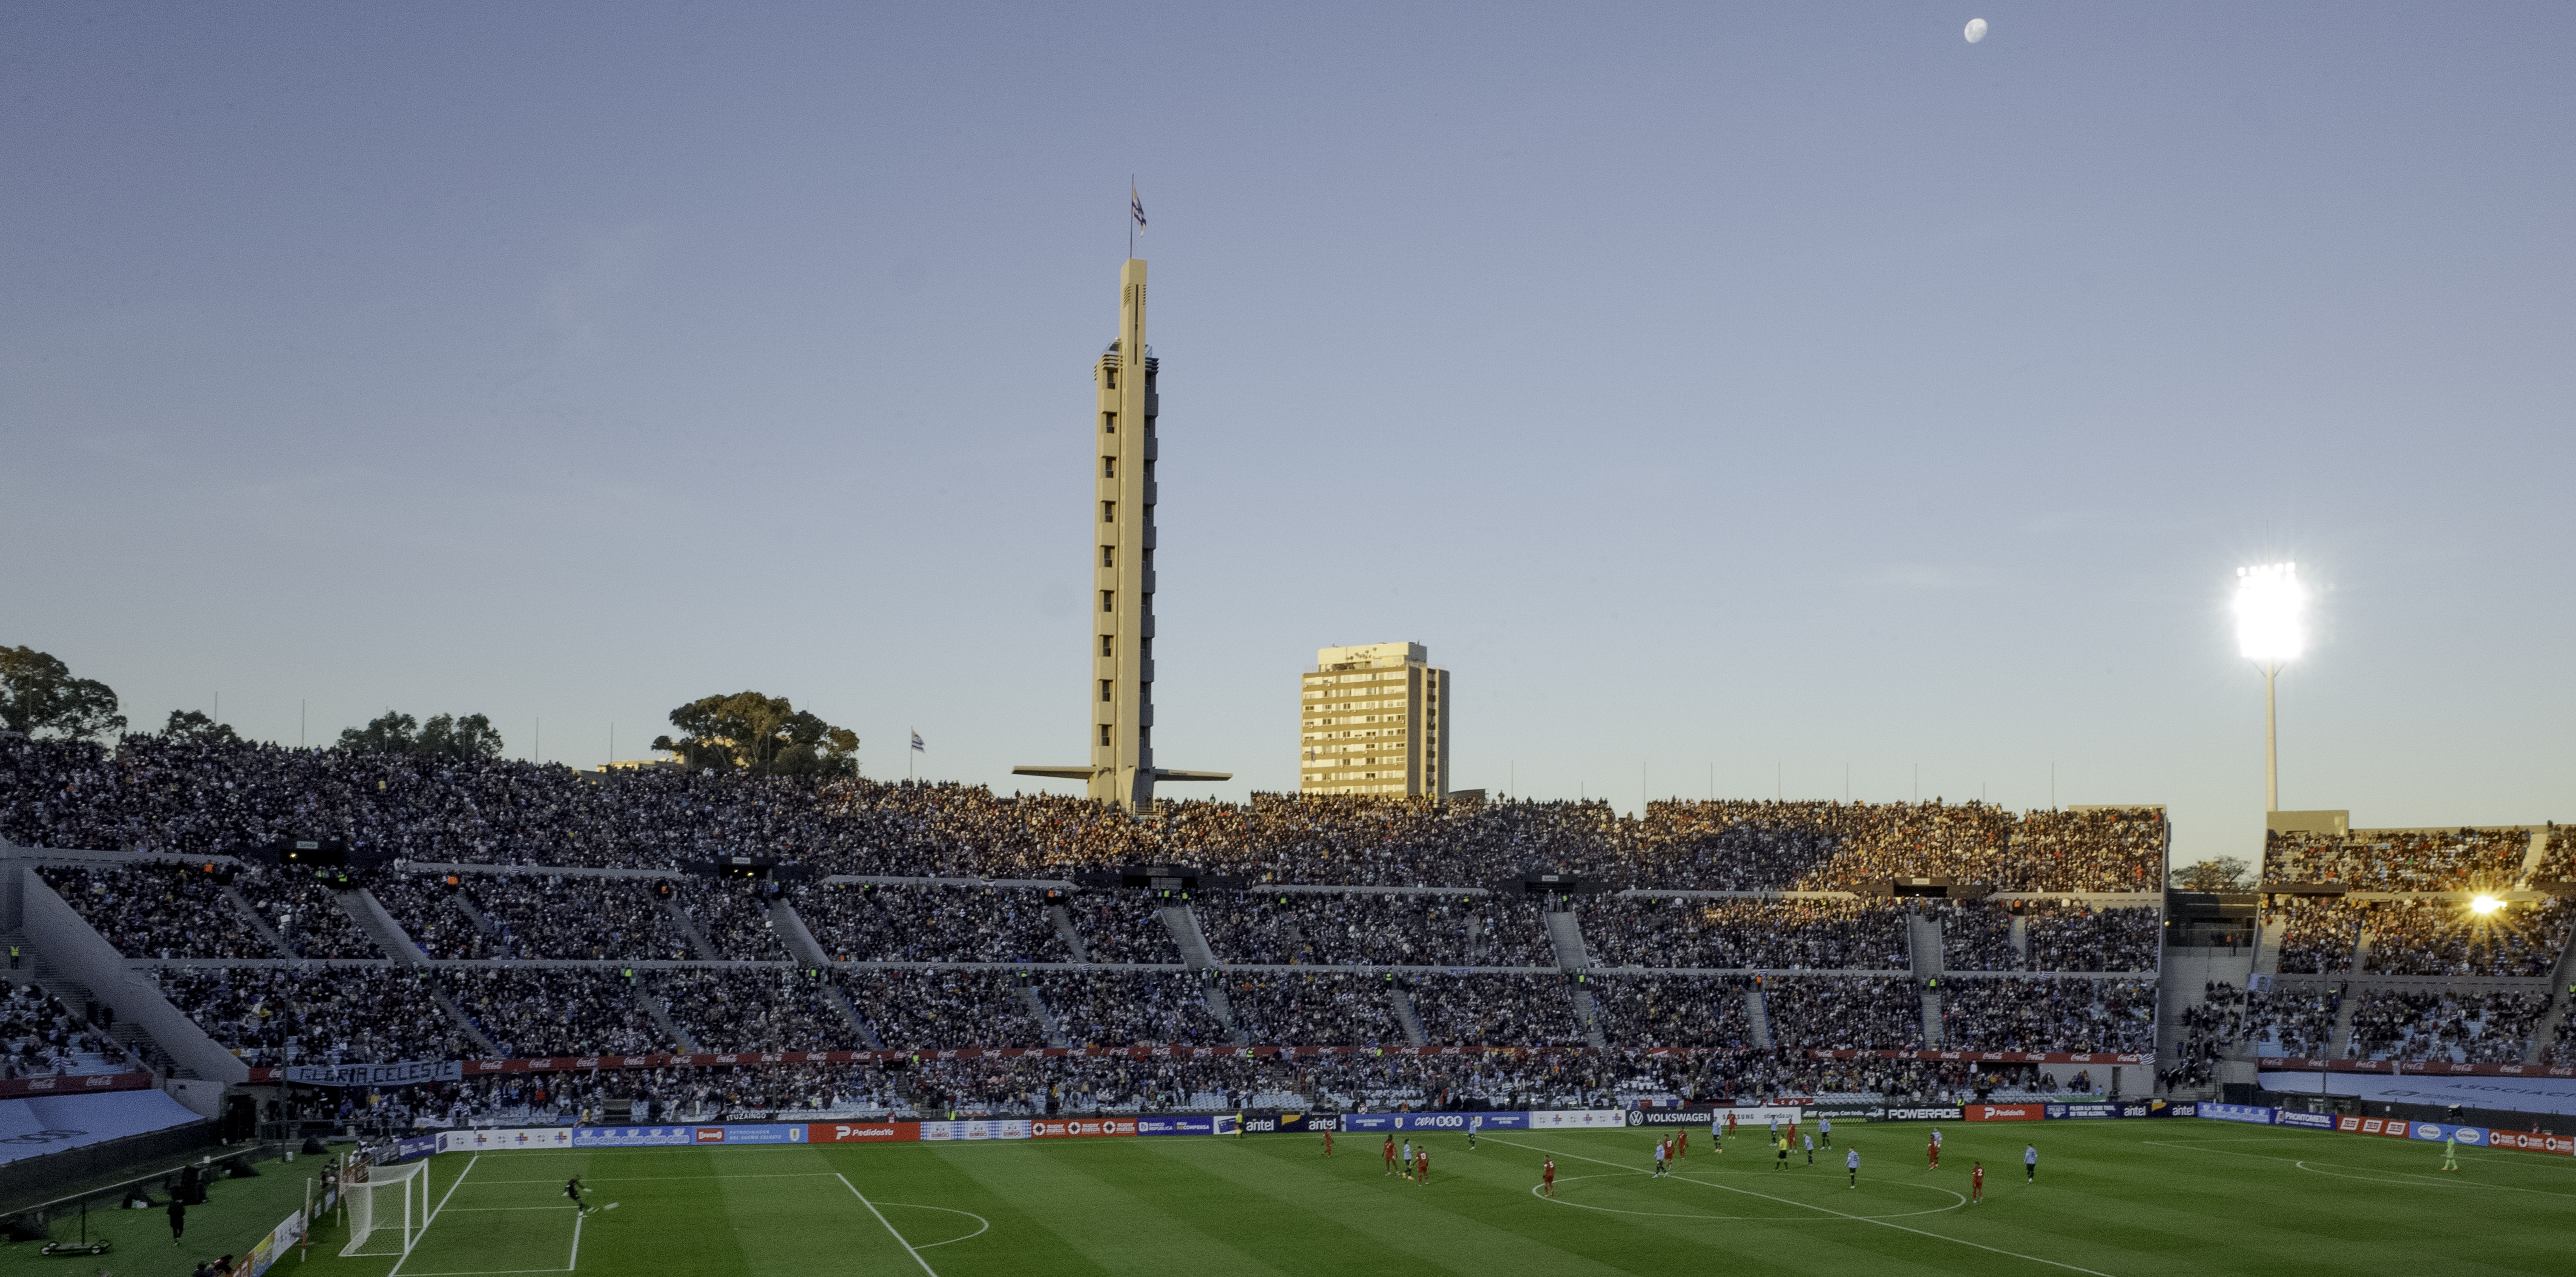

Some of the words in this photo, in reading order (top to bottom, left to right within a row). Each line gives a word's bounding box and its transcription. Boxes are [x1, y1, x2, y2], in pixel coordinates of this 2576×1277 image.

[716, 1054, 737, 1063] Coca-Cola
[806, 1052, 828, 1061] Coca-Cola
[851, 1051, 871, 1060] Coca-Cola
[938, 1050, 958, 1058] Coca-Cola
[2026, 1053, 2046, 1061] Coca-Cola
[2070, 1053, 2091, 1062] Coca-Cola
[2117, 1054, 2138, 1062] Coca-Cola
[528, 1059, 551, 1068] Coca-Cola
[576, 1058, 598, 1067] Coca-Cola
[624, 1057, 645, 1065] Coca-Cola
[670, 1056, 692, 1064] Coca-Cola
[480, 1061, 503, 1070] Coca-Cola
[2500, 1065, 2522, 1073] Coca-Cola
[374, 1061, 454, 1082] CELESTE
[2549, 1067, 2573, 1075] Coca-Cola
[28, 1079, 55, 1090] Coca-Cola
[86, 1076, 112, 1086] Coca-Cola
[2124, 1105, 2146, 1116] antel
[2173, 1105, 2195, 1116] antel
[1414, 1116, 1436, 1127] COPA
[1647, 1113, 1711, 1122] VOLKSWAGEN
[2285, 1111, 2331, 1123] PRONTOMETAL
[1246, 1119, 1274, 1131] antel
[1308, 1118, 1337, 1130] antel
[852, 1128, 894, 1136] PedidosYa
